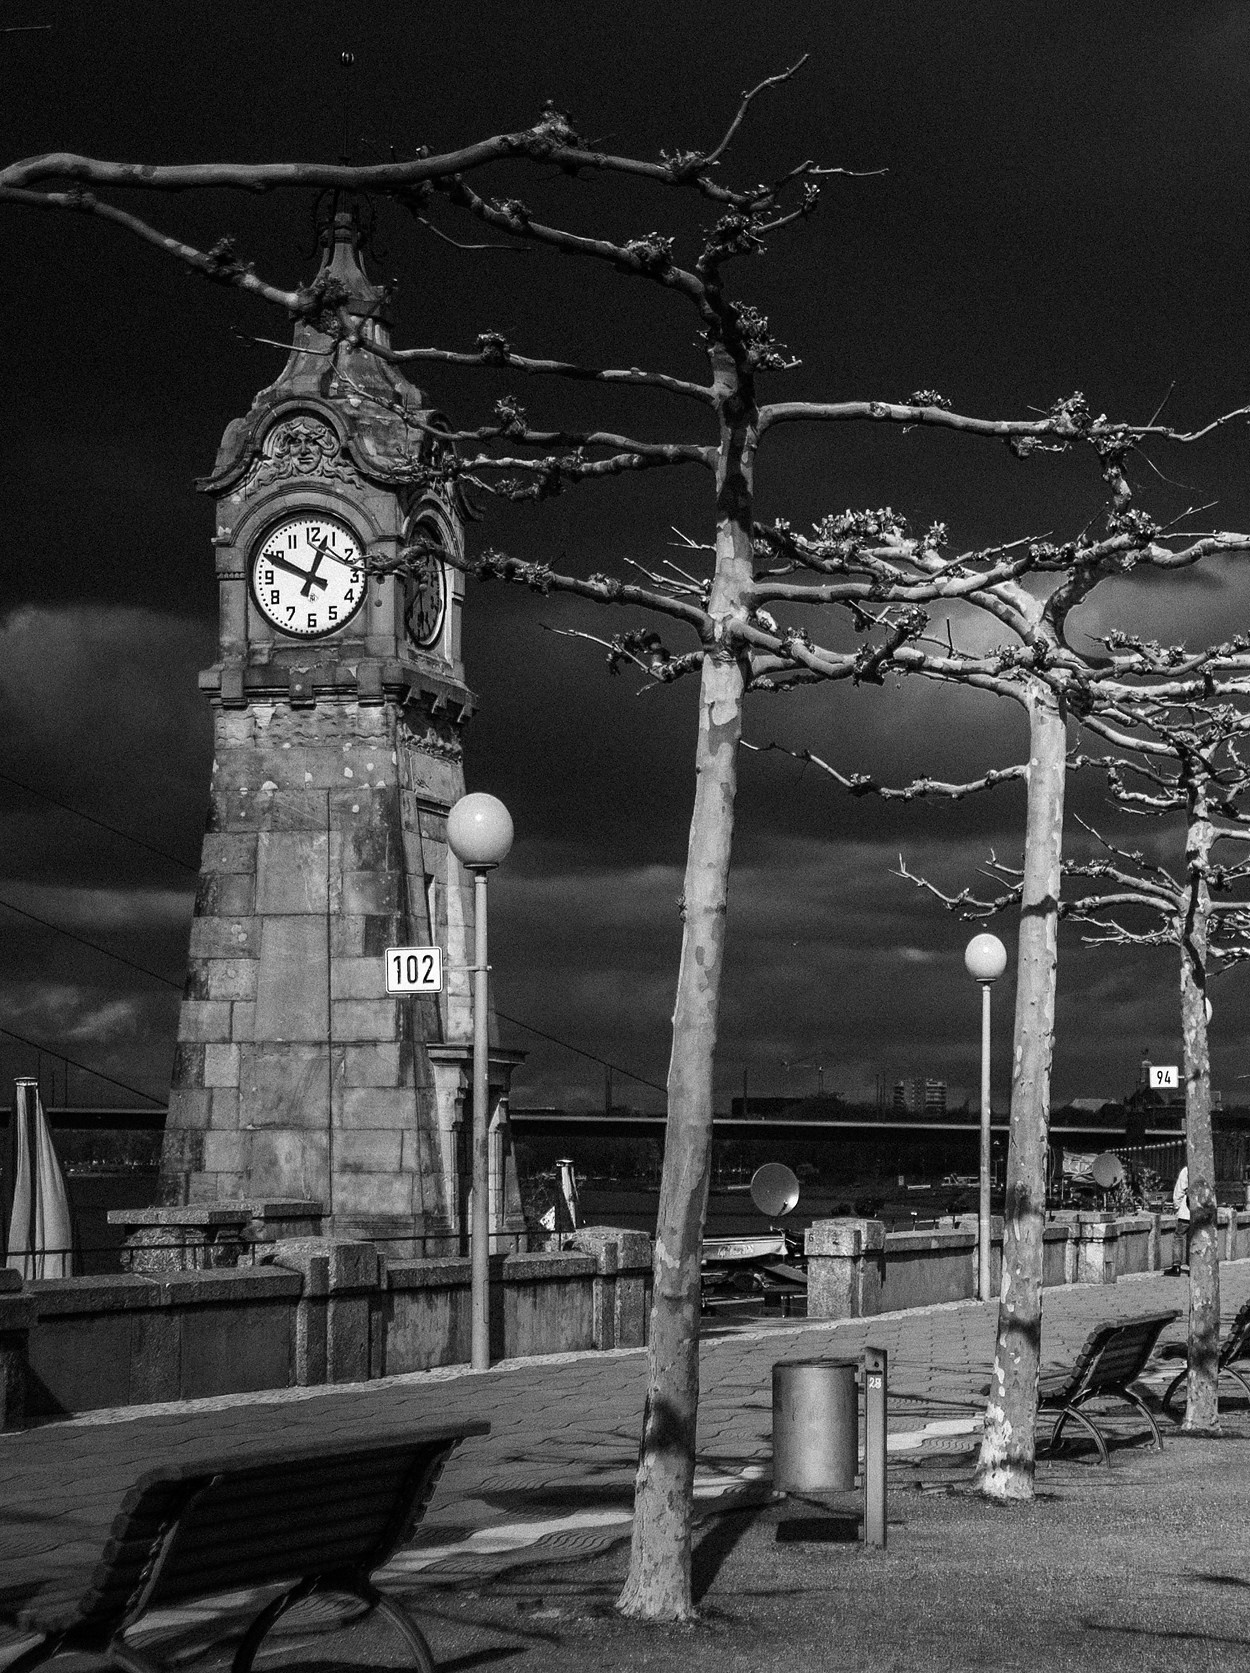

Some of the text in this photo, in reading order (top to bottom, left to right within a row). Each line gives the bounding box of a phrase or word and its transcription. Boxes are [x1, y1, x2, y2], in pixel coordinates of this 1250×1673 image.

[288, 534, 297, 549] 11
[306, 527, 321, 542] 12
[331, 531, 336, 547] 1
[344, 549, 354, 564] 2
[264, 570, 274, 585] 9
[349, 569, 360, 583] 3
[270, 590, 280, 605] 8
[343, 588, 354, 603] 4
[286, 606, 296, 621] 7
[328, 605, 338, 620] 5
[307, 613, 317, 628] 6
[393, 954, 435, 985] 102
[1156, 1070, 1171, 1085] 94
